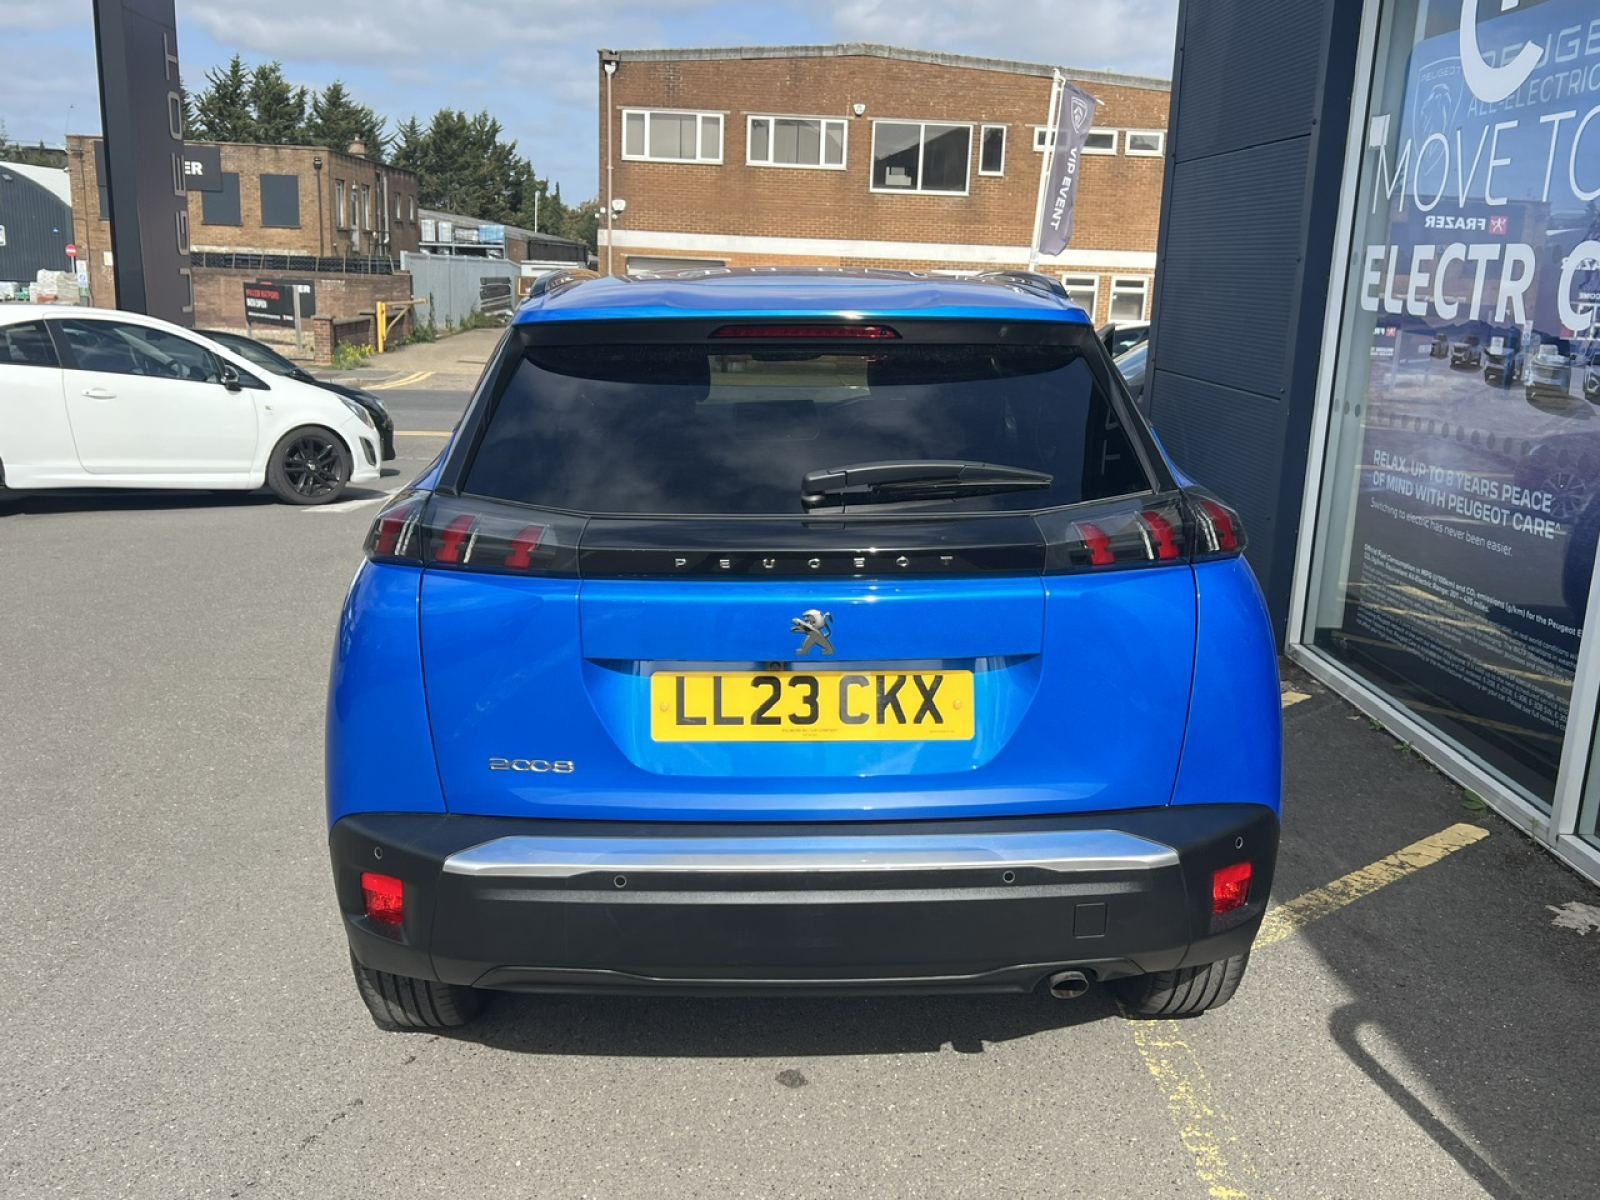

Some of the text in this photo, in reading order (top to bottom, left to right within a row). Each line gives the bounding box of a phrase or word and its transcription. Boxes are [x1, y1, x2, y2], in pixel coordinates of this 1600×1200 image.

[1051, 147, 1078, 231] VIP EVENT
[1372, 119, 1519, 214] MOVE
[1373, 470, 1386, 486] OF
[1386, 474, 1413, 497] MIND
[1415, 483, 1446, 508] WITH
[1448, 494, 1511, 527] PEUGEOT
[1410, 459, 1427, 478] UP
[1428, 464, 1445, 484] TO
[1445, 469, 1454, 486] 8
[1455, 472, 1499, 499] YEARS
[1502, 484, 1553, 514] PEACE
[1398, 510, 1406, 520] to
[1406, 513, 1430, 529] electric
[1429, 519, 1443, 533] has
[1444, 525, 1465, 540] never
[1465, 531, 1486, 547] been
[675, 555, 954, 570] PEUGEOT
[1525, 610, 1536, 621] for
[1535, 614, 1547, 626] the
[1547, 618, 1576, 636] Peugeot
[675, 673, 945, 726] LL23 CKX
[488, 758, 576, 775] 2008
